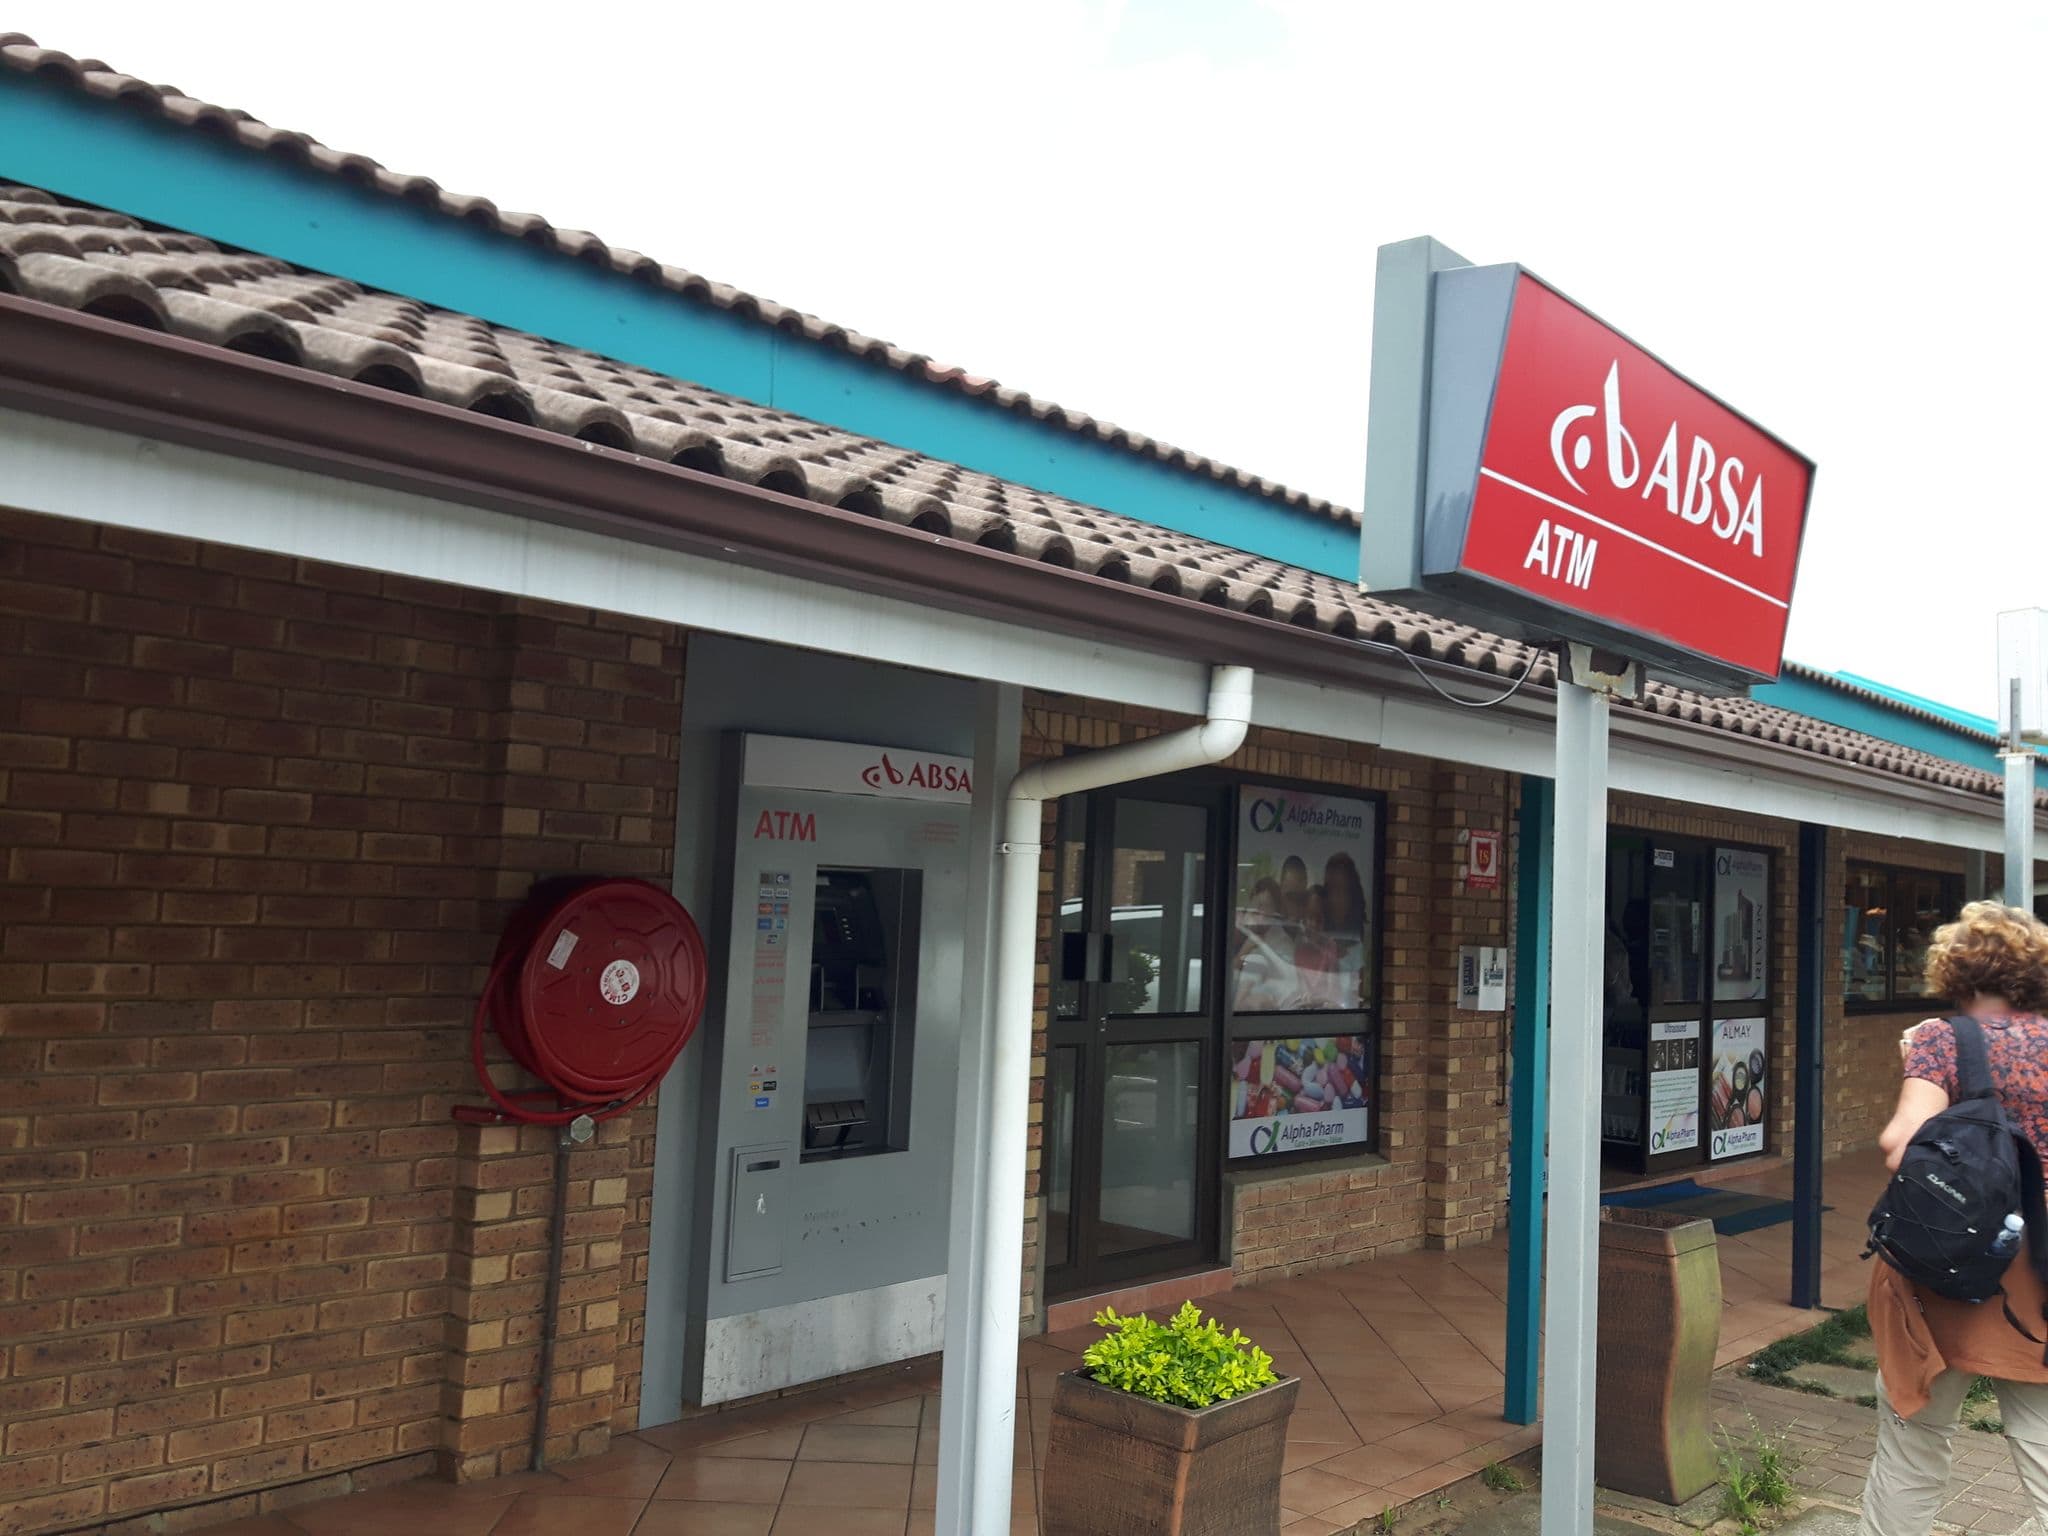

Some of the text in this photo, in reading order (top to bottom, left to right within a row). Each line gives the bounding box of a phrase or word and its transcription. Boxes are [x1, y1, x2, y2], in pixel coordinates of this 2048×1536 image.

[1642, 421, 1764, 558] ABSA
[1524, 518, 1598, 590] ATM
[907, 761, 973, 793] ABSA
[754, 810, 817, 842] ATM
[1722, 1024, 1752, 1040] ALMAY
